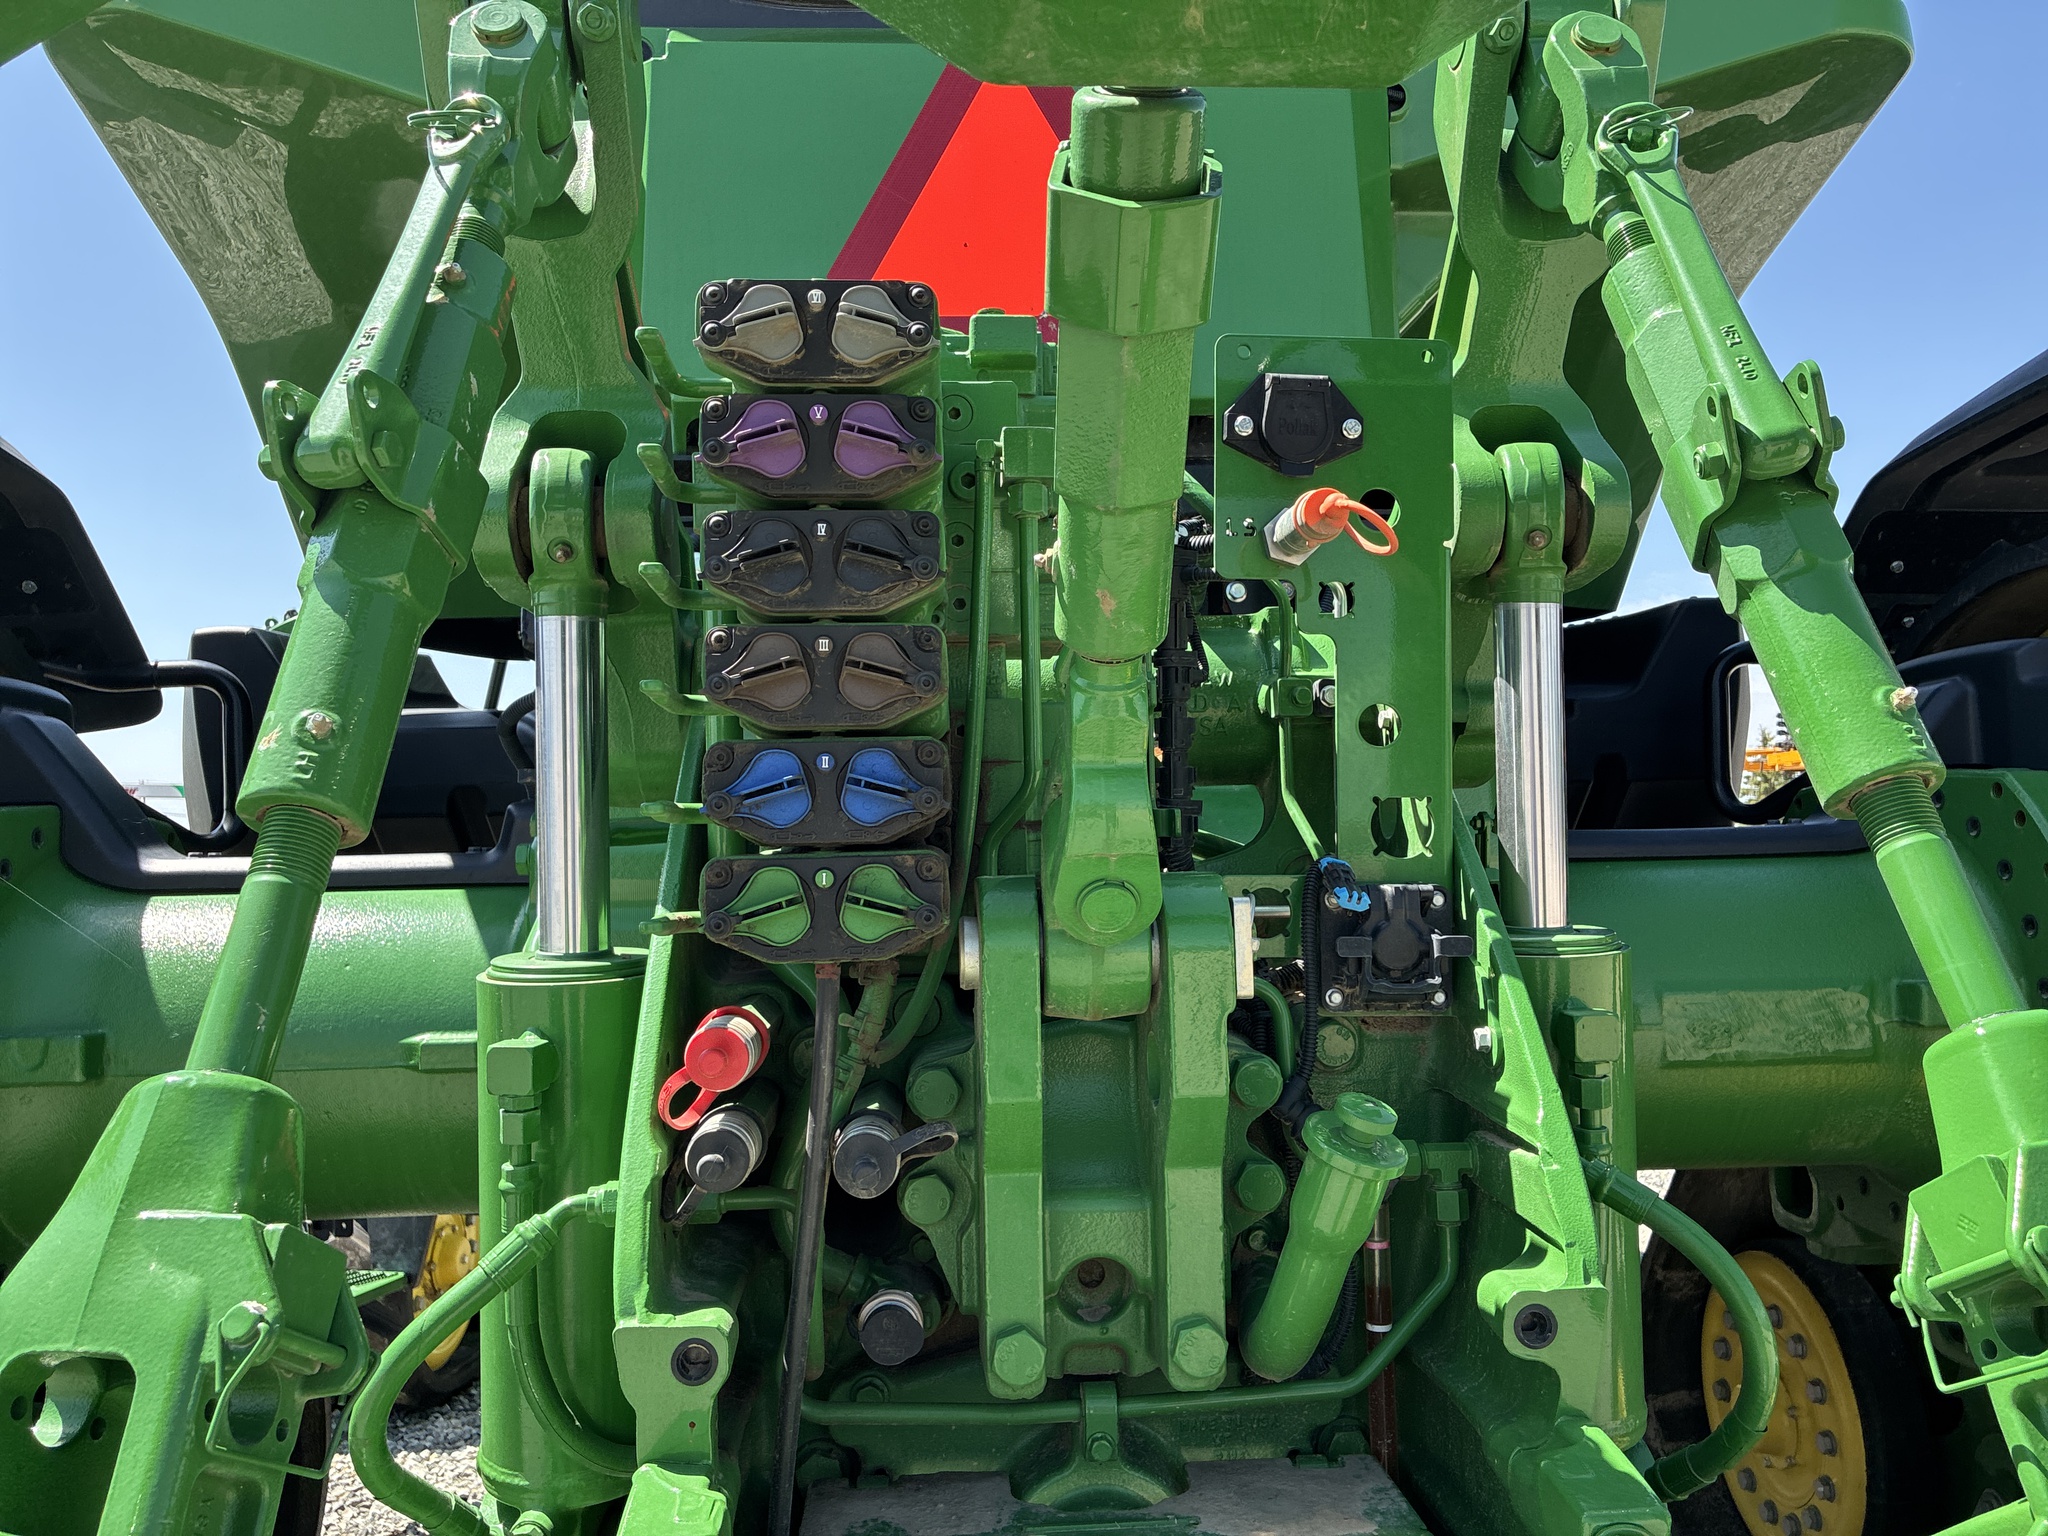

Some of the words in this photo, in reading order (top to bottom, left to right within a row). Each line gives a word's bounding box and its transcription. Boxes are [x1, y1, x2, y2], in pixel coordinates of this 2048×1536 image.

[811, 291, 822, 304] VI
[813, 406, 824, 419] V
[1278, 417, 1320, 436] Pollak
[817, 523, 827, 536] IV
[818, 639, 830, 652] III
[821, 756, 829, 768] II
[822, 872, 827, 885] I
